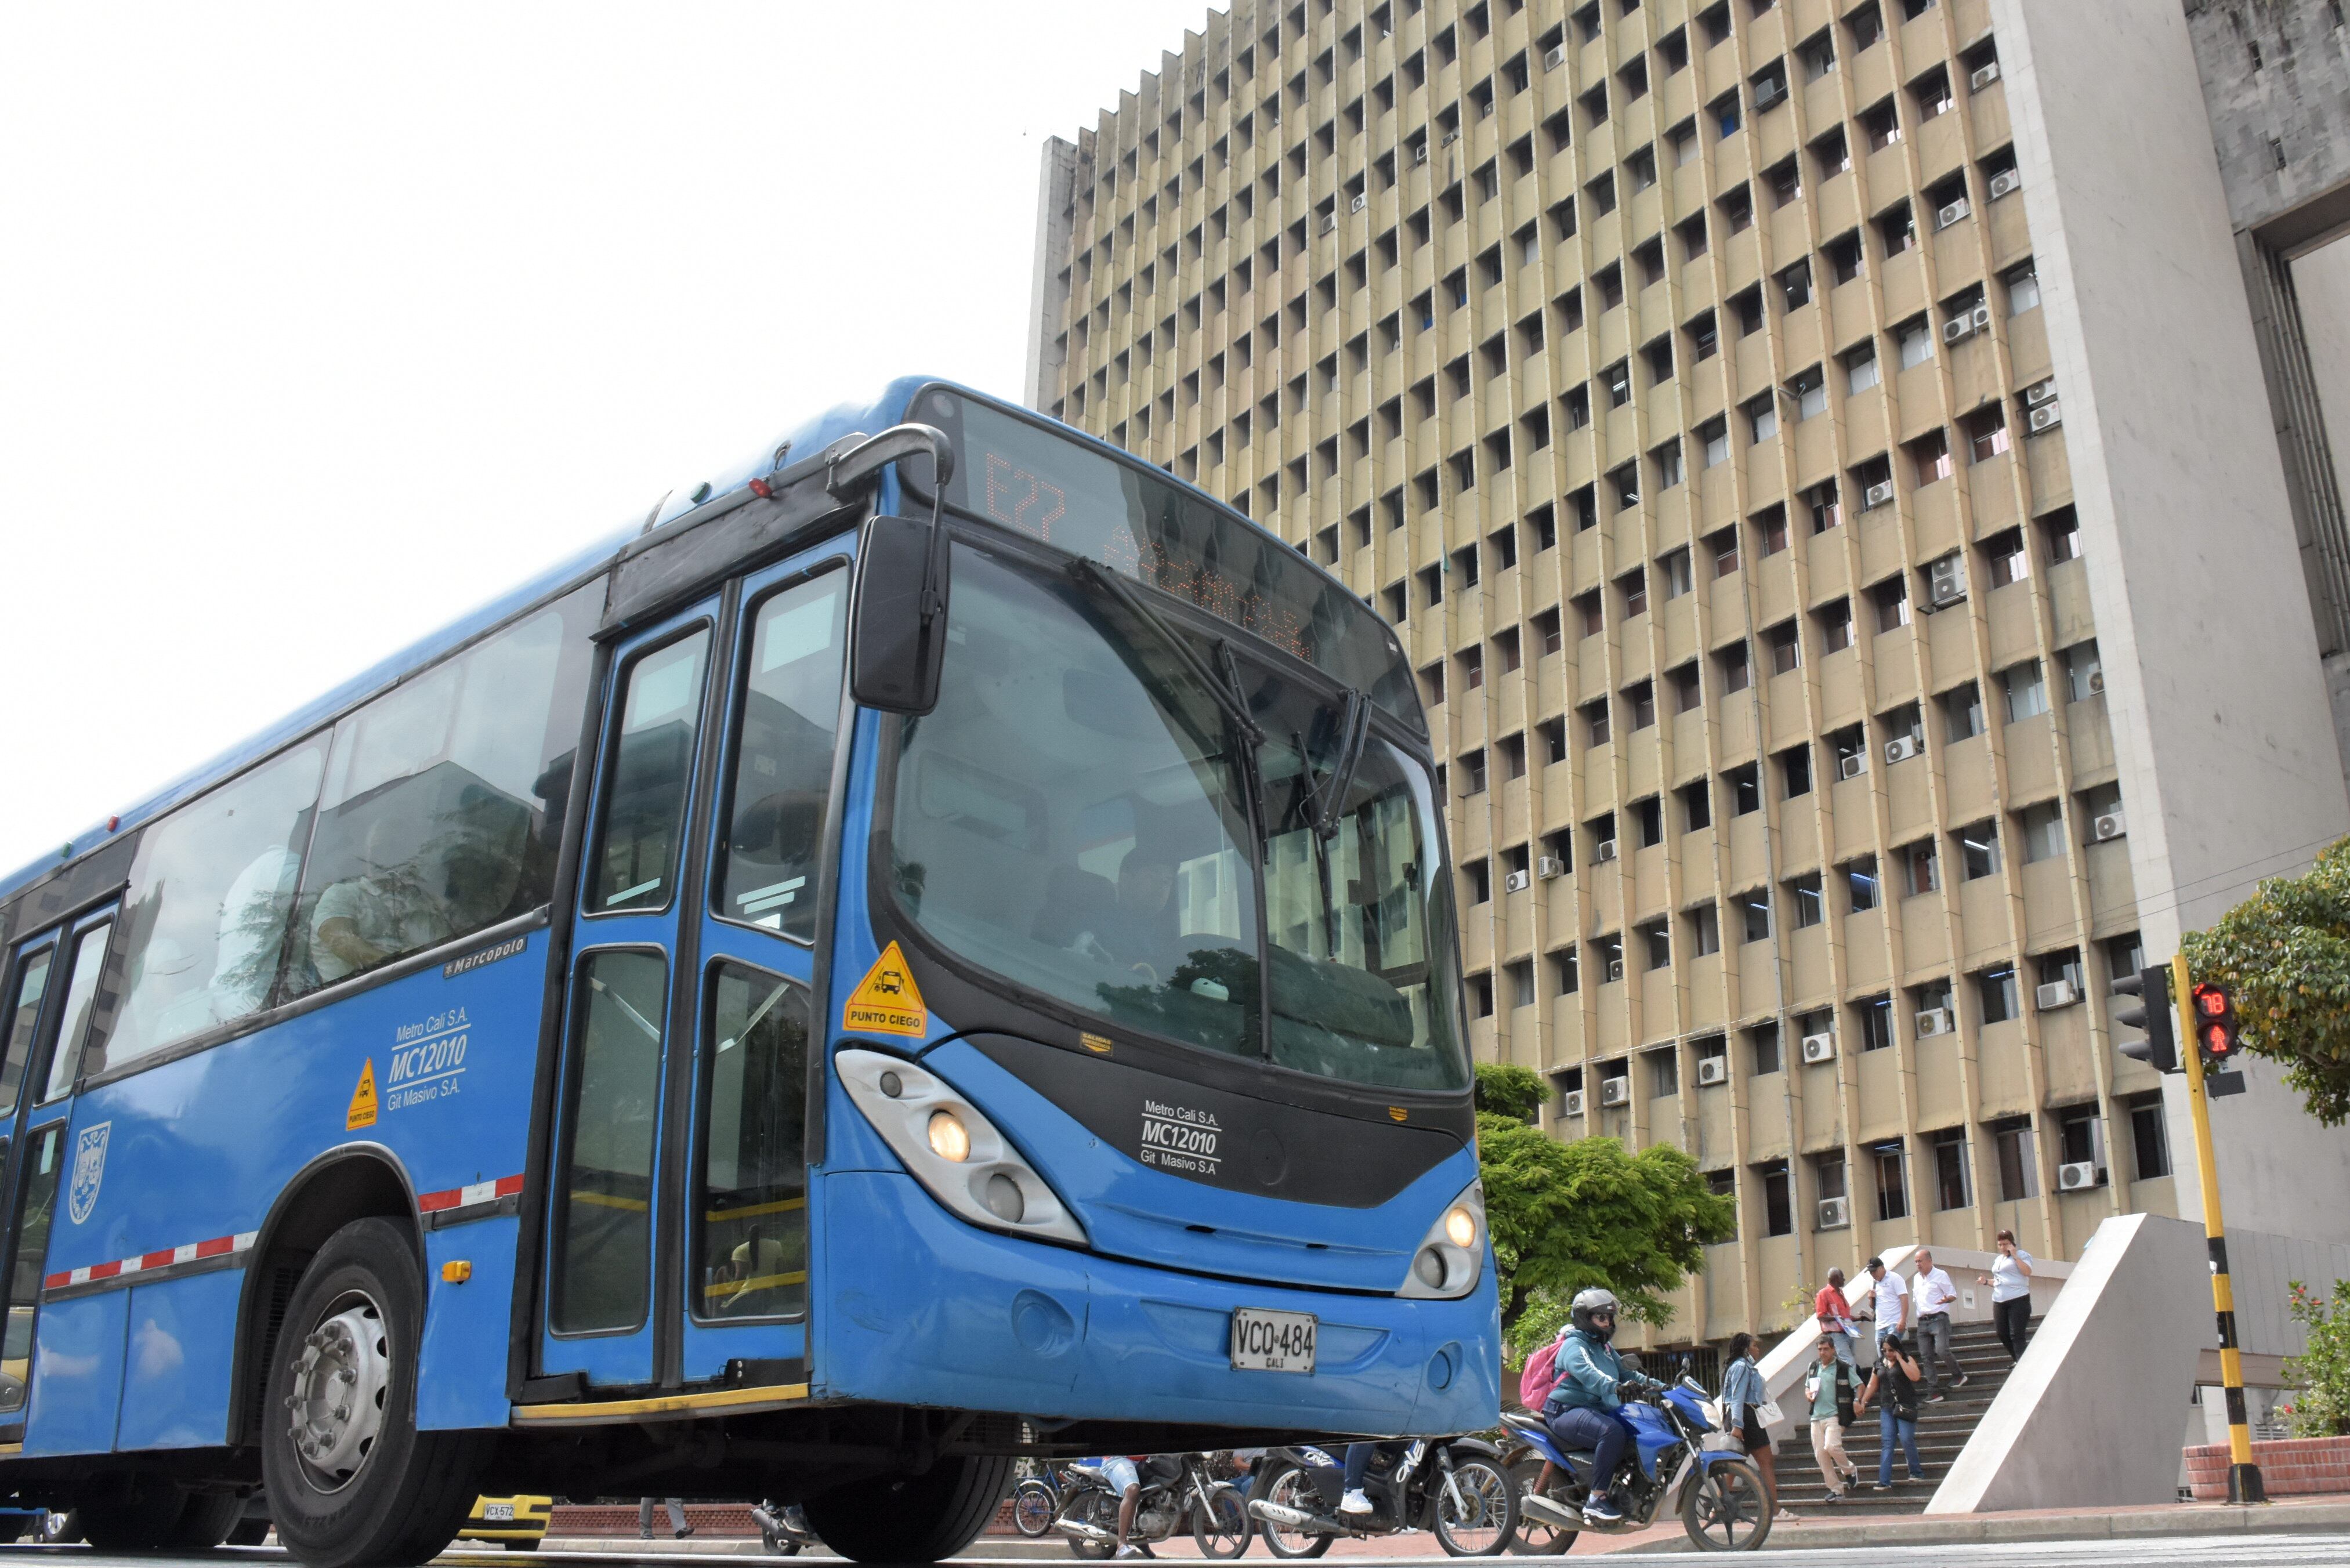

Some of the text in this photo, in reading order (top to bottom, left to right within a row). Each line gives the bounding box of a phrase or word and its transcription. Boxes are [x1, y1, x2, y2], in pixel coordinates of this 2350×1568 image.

[986, 452, 1066, 542] E27
[454, 938, 523, 973] Marcopolo
[851, 1011, 920, 1027] PUNTO CIEGO
[2201, 993, 2225, 1014] 78
[396, 1006, 468, 1042] Metro Cali S.A.
[389, 1035, 467, 1083] MC12010
[388, 1078, 460, 1111] Git Masivo S.A.
[1145, 1100, 1218, 1126] Metro Cali S.A.
[1142, 1121, 1216, 1154] MC12010
[1141, 1150, 1156, 1164] Git
[1161, 1154, 1196, 1171] Masivo
[1266, 1357, 1284, 1368] CALI
